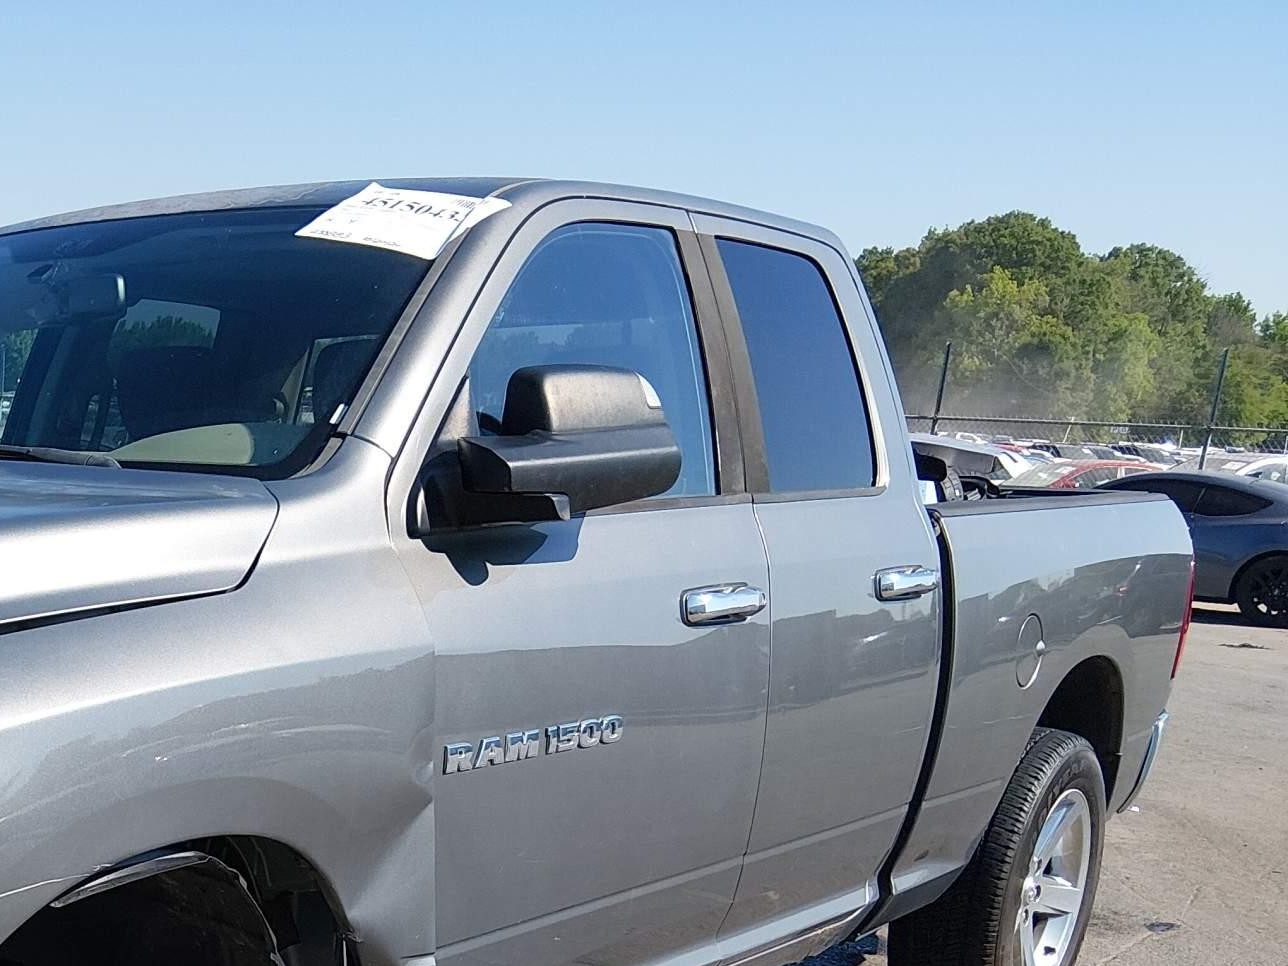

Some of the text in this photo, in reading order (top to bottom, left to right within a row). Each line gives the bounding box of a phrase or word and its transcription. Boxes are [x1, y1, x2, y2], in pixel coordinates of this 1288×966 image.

[362, 197, 460, 222] 4515043
[442, 714, 623, 775] RAM 1500
